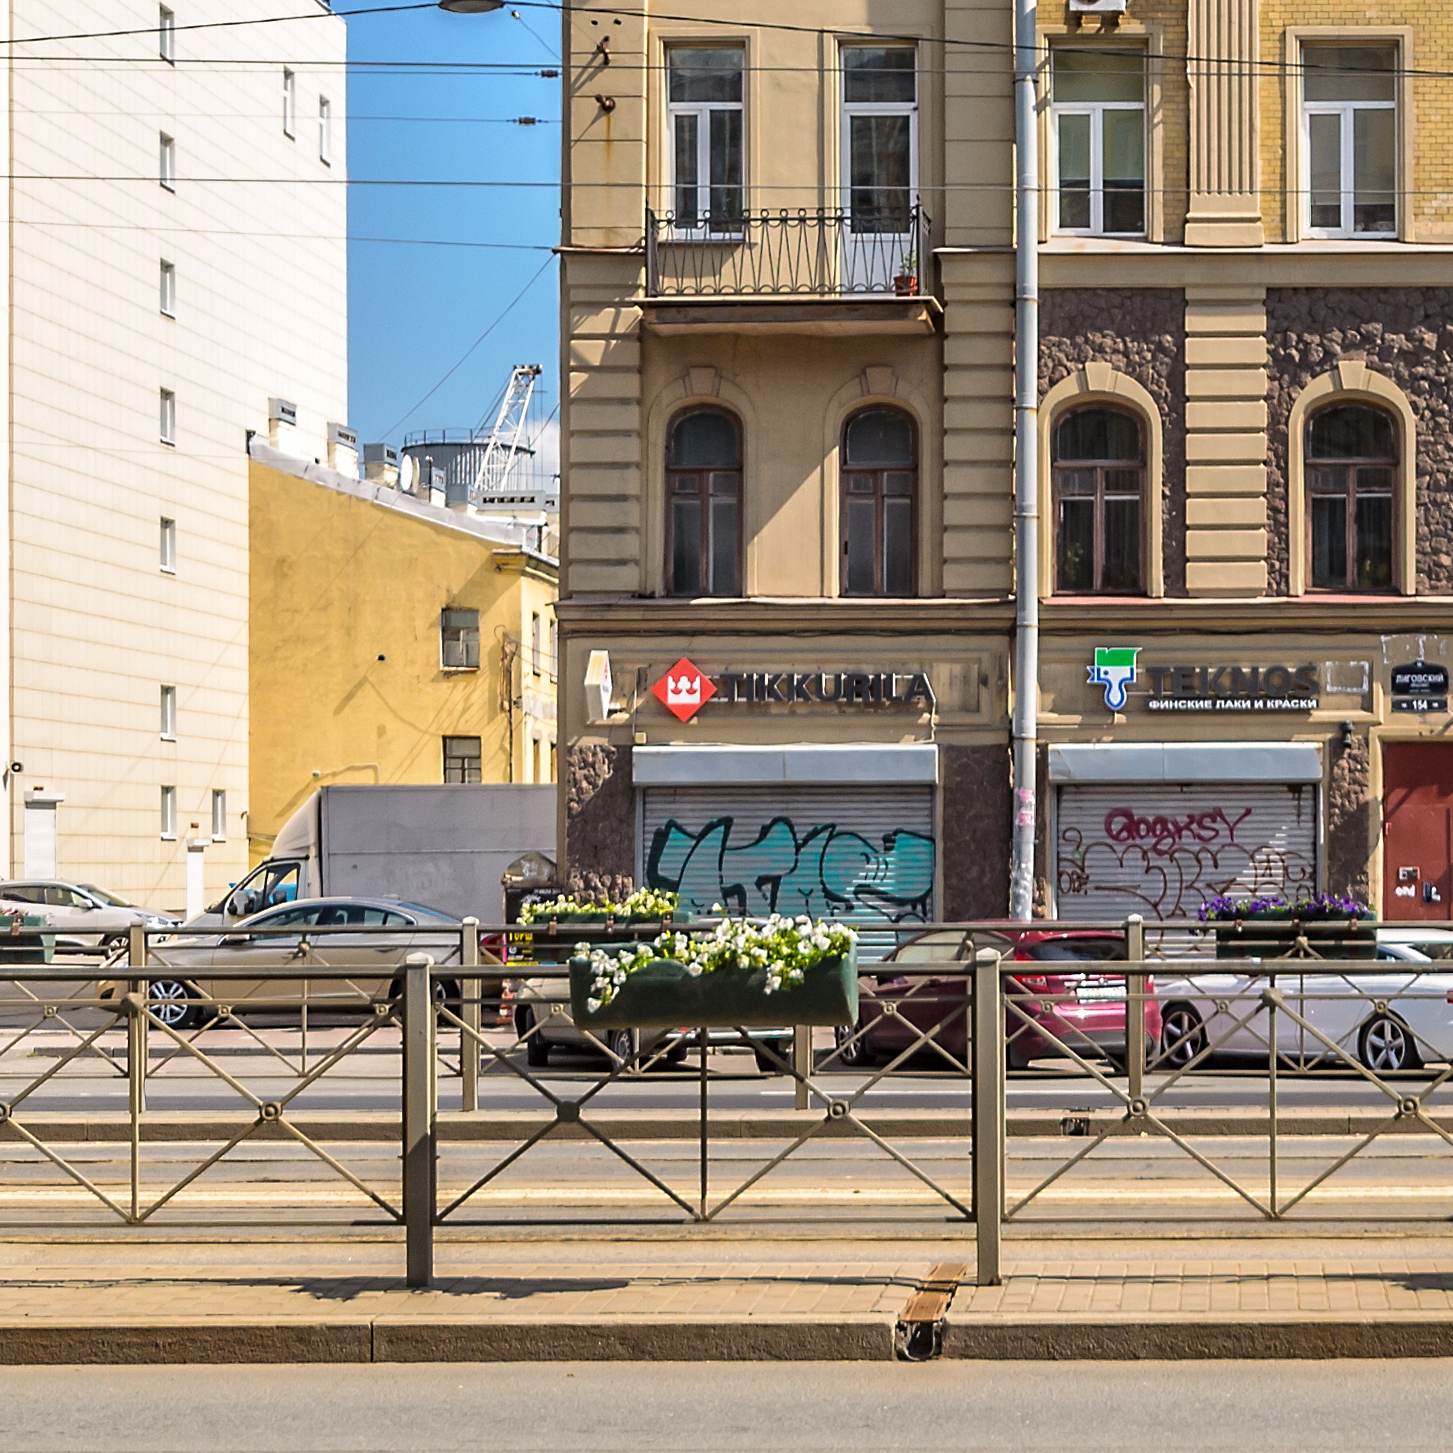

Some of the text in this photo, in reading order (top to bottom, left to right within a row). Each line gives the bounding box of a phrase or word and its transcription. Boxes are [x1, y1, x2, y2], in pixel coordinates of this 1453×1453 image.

[1145, 665, 1320, 698] TEKNOS
[1395, 672, 1444, 684] ЛИГОВСКИЙ
[719, 672, 935, 703] TIKKURILA
[1148, 699, 1317, 709] ФИНСКИЕ ЛАКИ И КРАСКИ
[1412, 699, 1428, 710] 154
